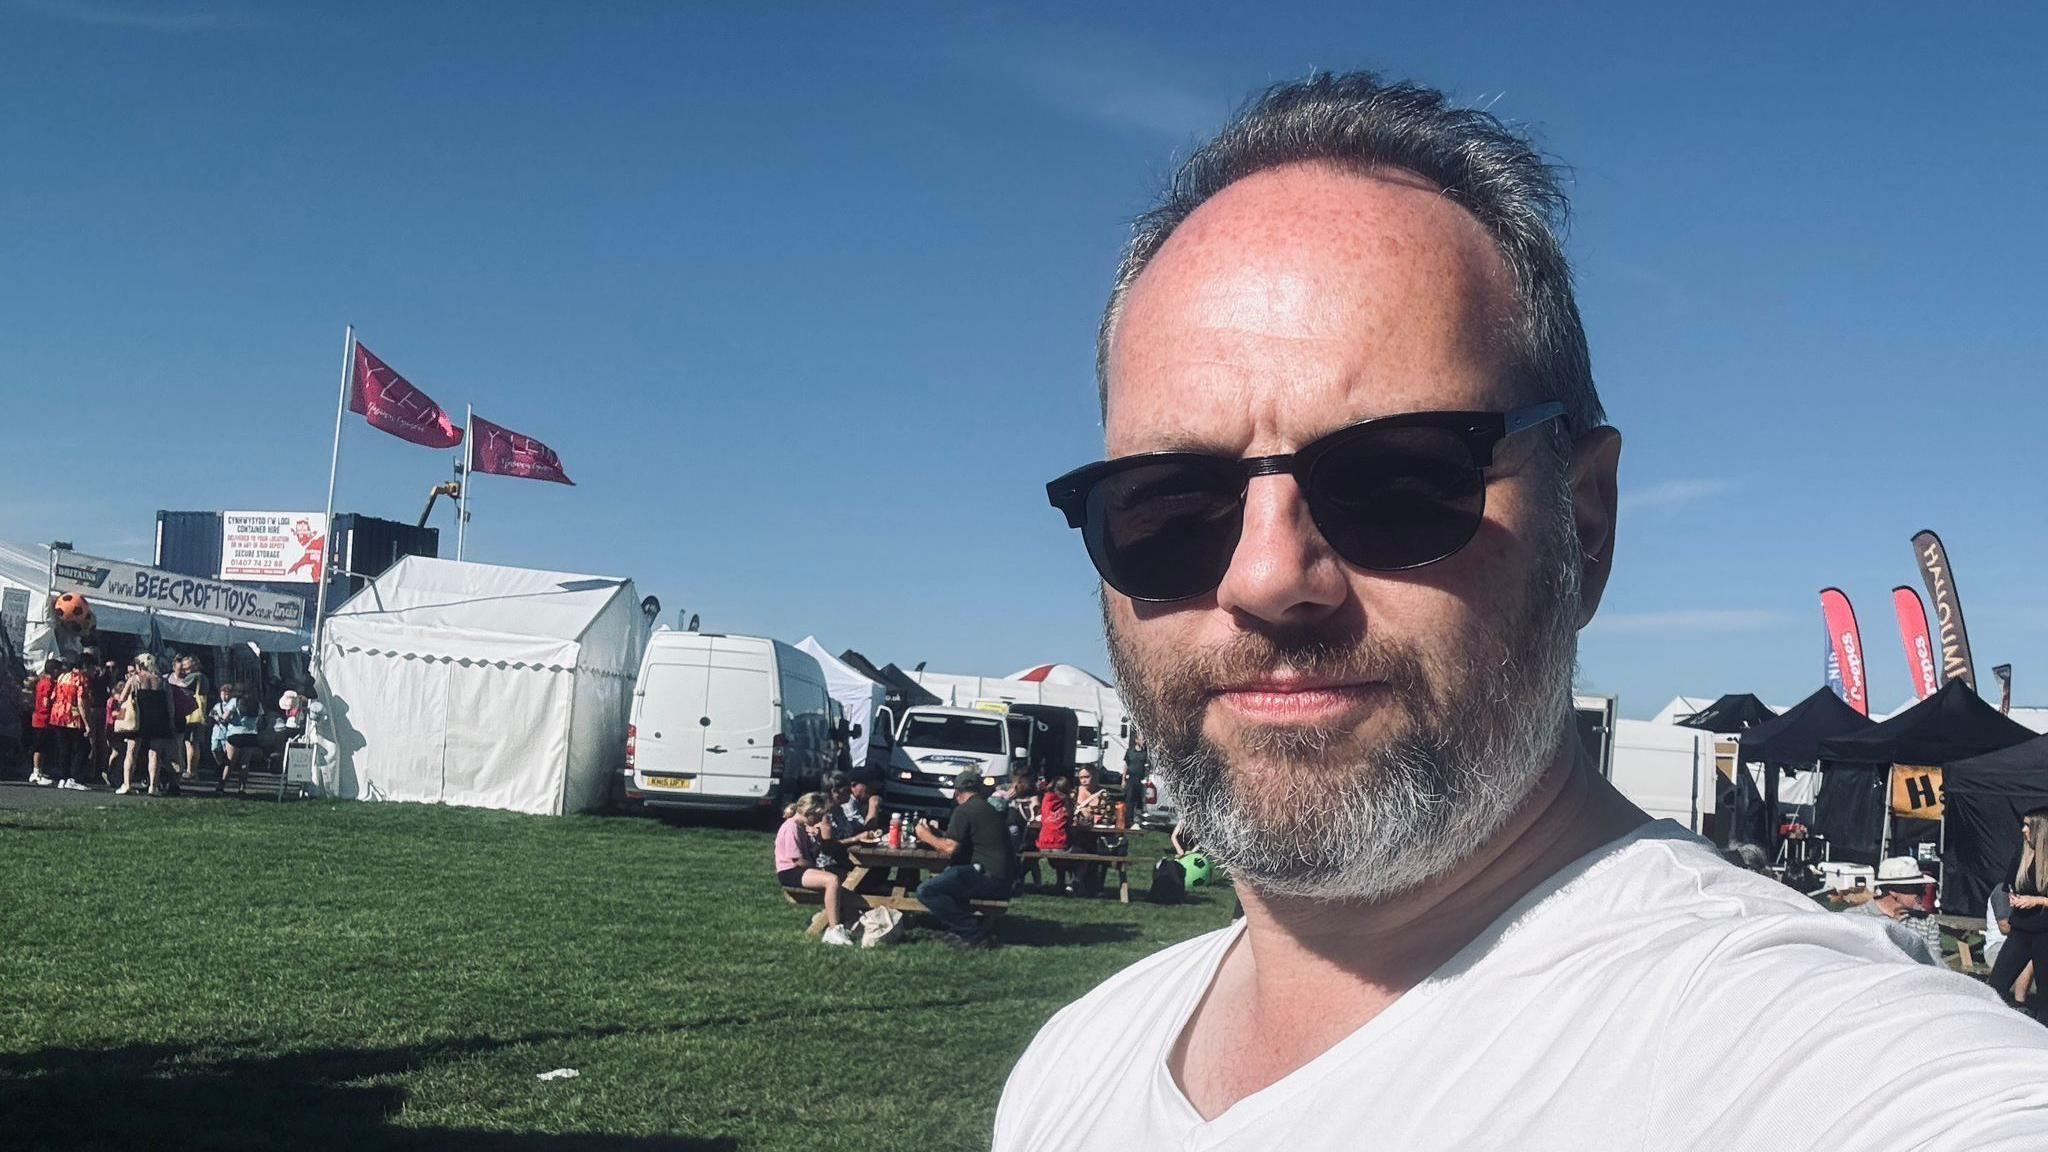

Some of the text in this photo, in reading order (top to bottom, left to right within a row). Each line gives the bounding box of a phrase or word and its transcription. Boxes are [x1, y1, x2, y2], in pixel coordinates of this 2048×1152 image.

[237, 525, 280, 534] CONTAINER HIRE
[235, 549, 280, 558] SECURE STORAGE
[230, 558, 252, 566] 01407
[1922, 543, 1968, 679] HALLOUMI
[1914, 635, 1937, 700] repes
